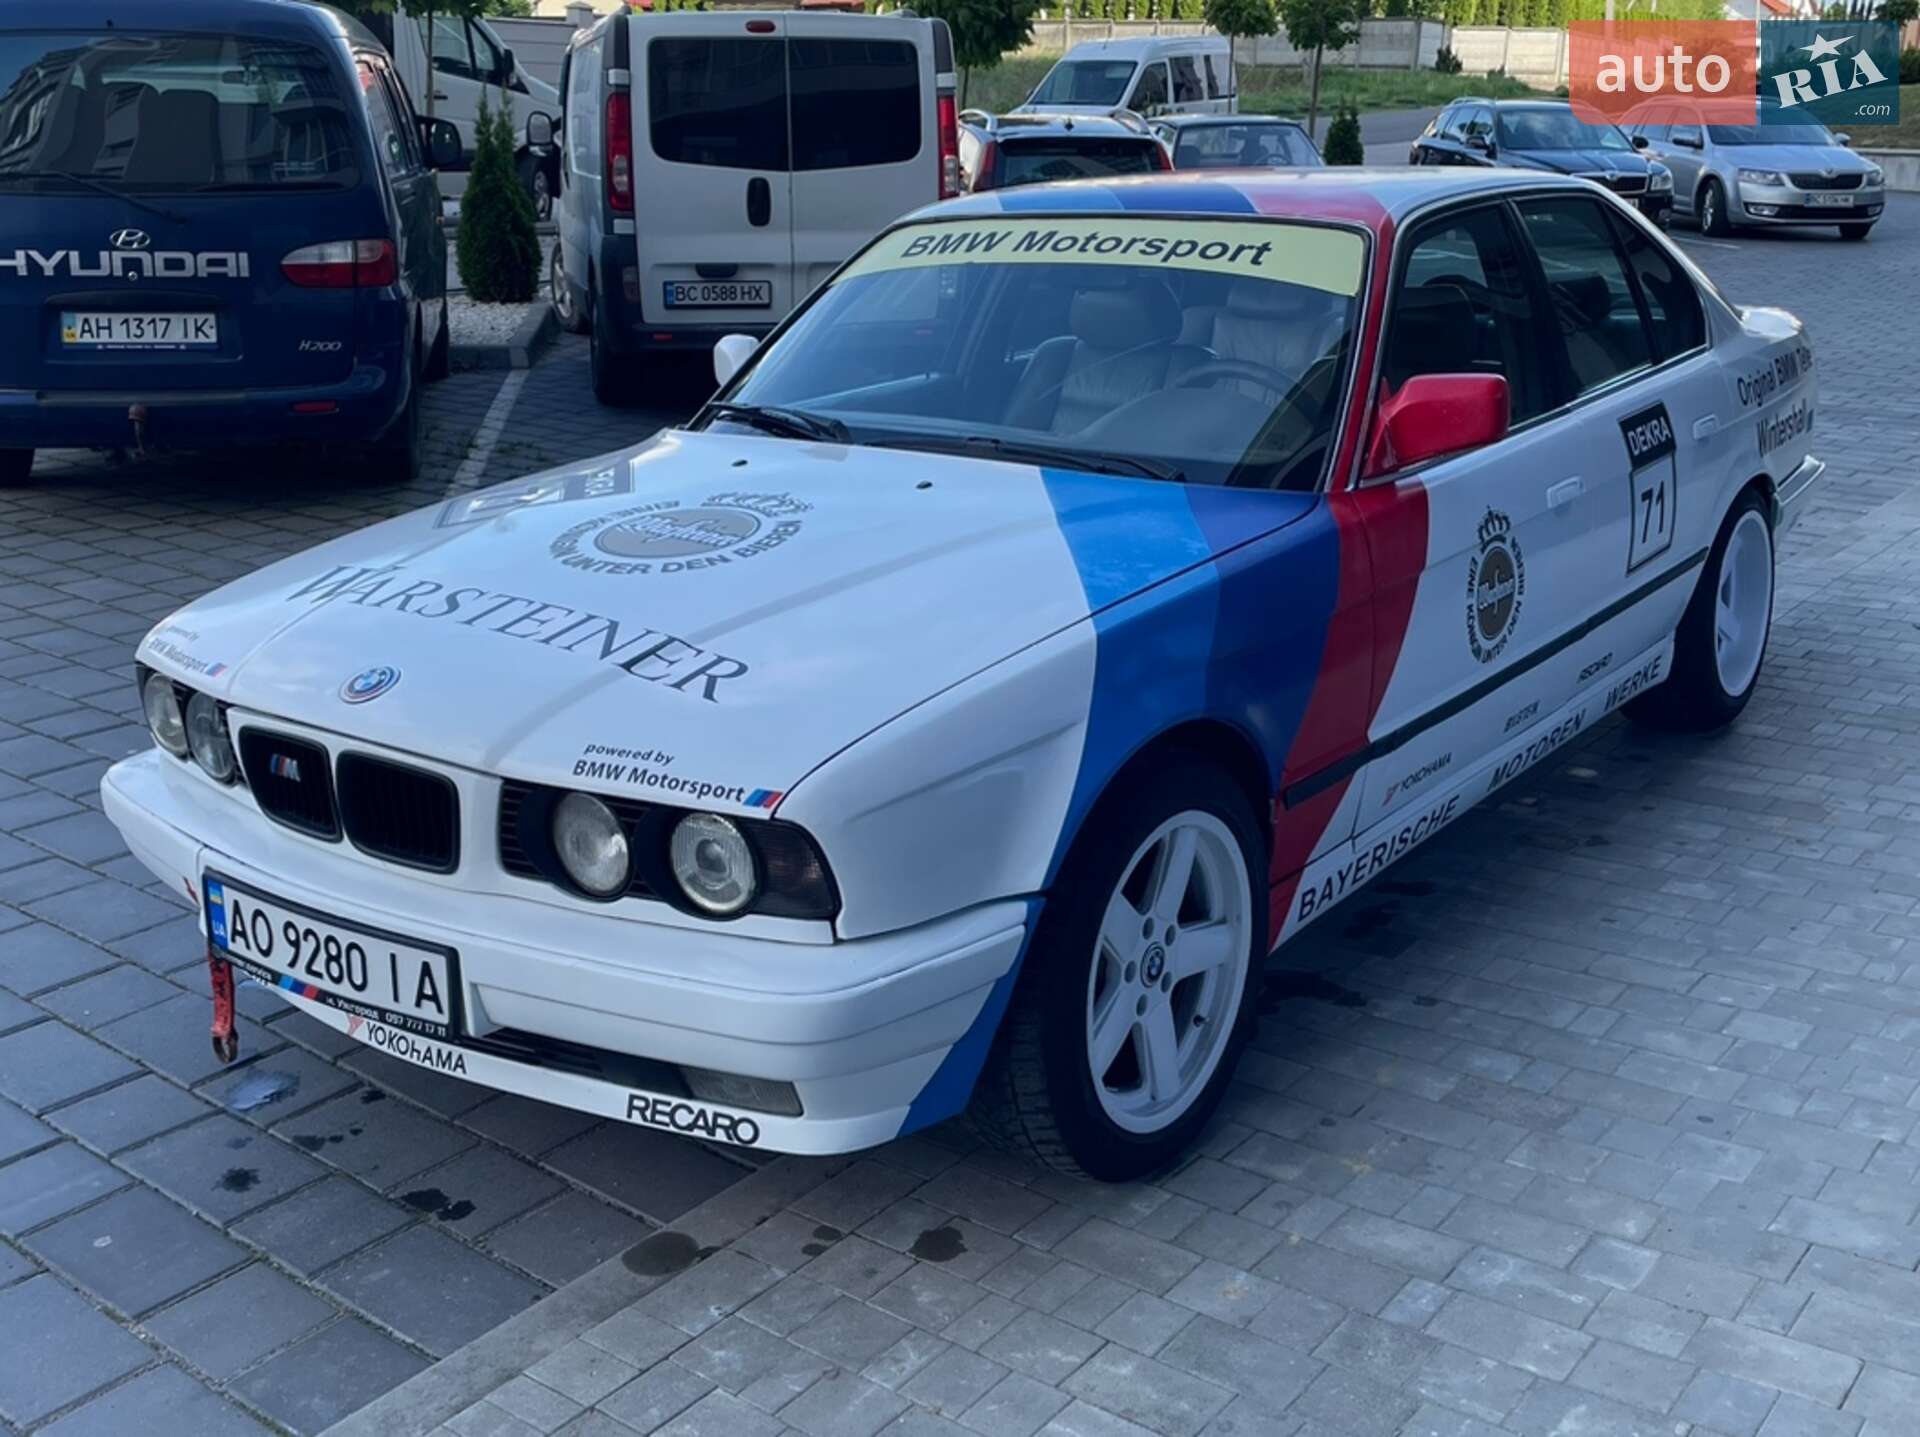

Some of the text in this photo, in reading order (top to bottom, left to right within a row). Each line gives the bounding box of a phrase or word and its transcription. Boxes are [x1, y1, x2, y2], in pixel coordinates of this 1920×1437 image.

[0, 250, 249, 277] HYUNDAI
[901, 230, 1273, 266] BMW Motorsport
[675, 285, 763, 301] BC 0588 HX
[79, 317, 113, 339] AH
[119, 317, 171, 339] 1317
[298, 339, 342, 352] H200
[1737, 360, 1777, 408] Original
[1627, 415, 1672, 457] DEKRA
[1641, 479, 1664, 544] 71
[571, 556, 652, 575] UNTER
[660, 554, 732, 573] DEN
[287, 564, 749, 703] WARSTEINER
[584, 743, 675, 766] powered by
[572, 759, 746, 802] BMW Motorsport
[1297, 654, 1662, 922] BAYERISCHE MOTOREN WERKE
[230, 899, 274, 958] AO
[283, 920, 369, 992] 9280
[626, 1094, 760, 1145] RECARO
